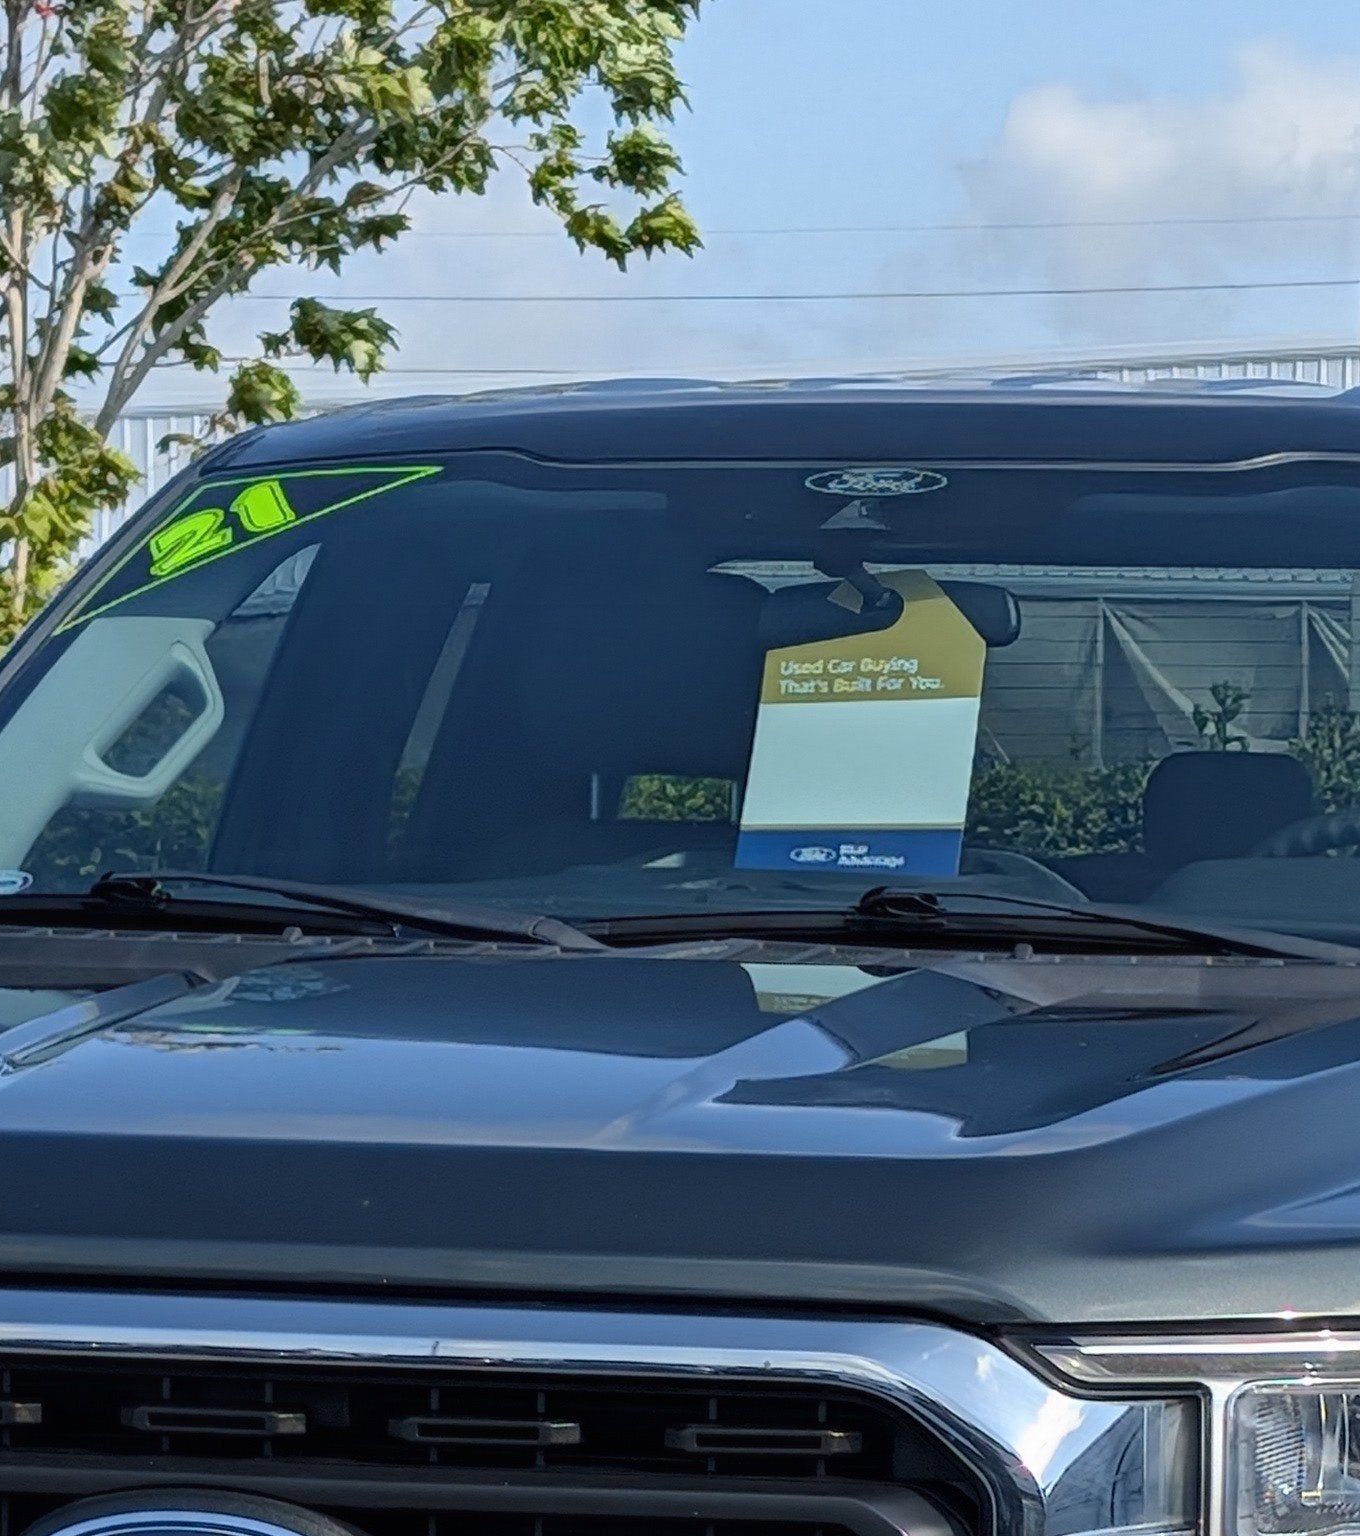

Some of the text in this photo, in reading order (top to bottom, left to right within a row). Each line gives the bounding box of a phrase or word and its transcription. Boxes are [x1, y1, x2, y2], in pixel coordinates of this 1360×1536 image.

[780, 656, 919, 675] Used Car Buying
[779, 675, 945, 695] That's Built For You.
